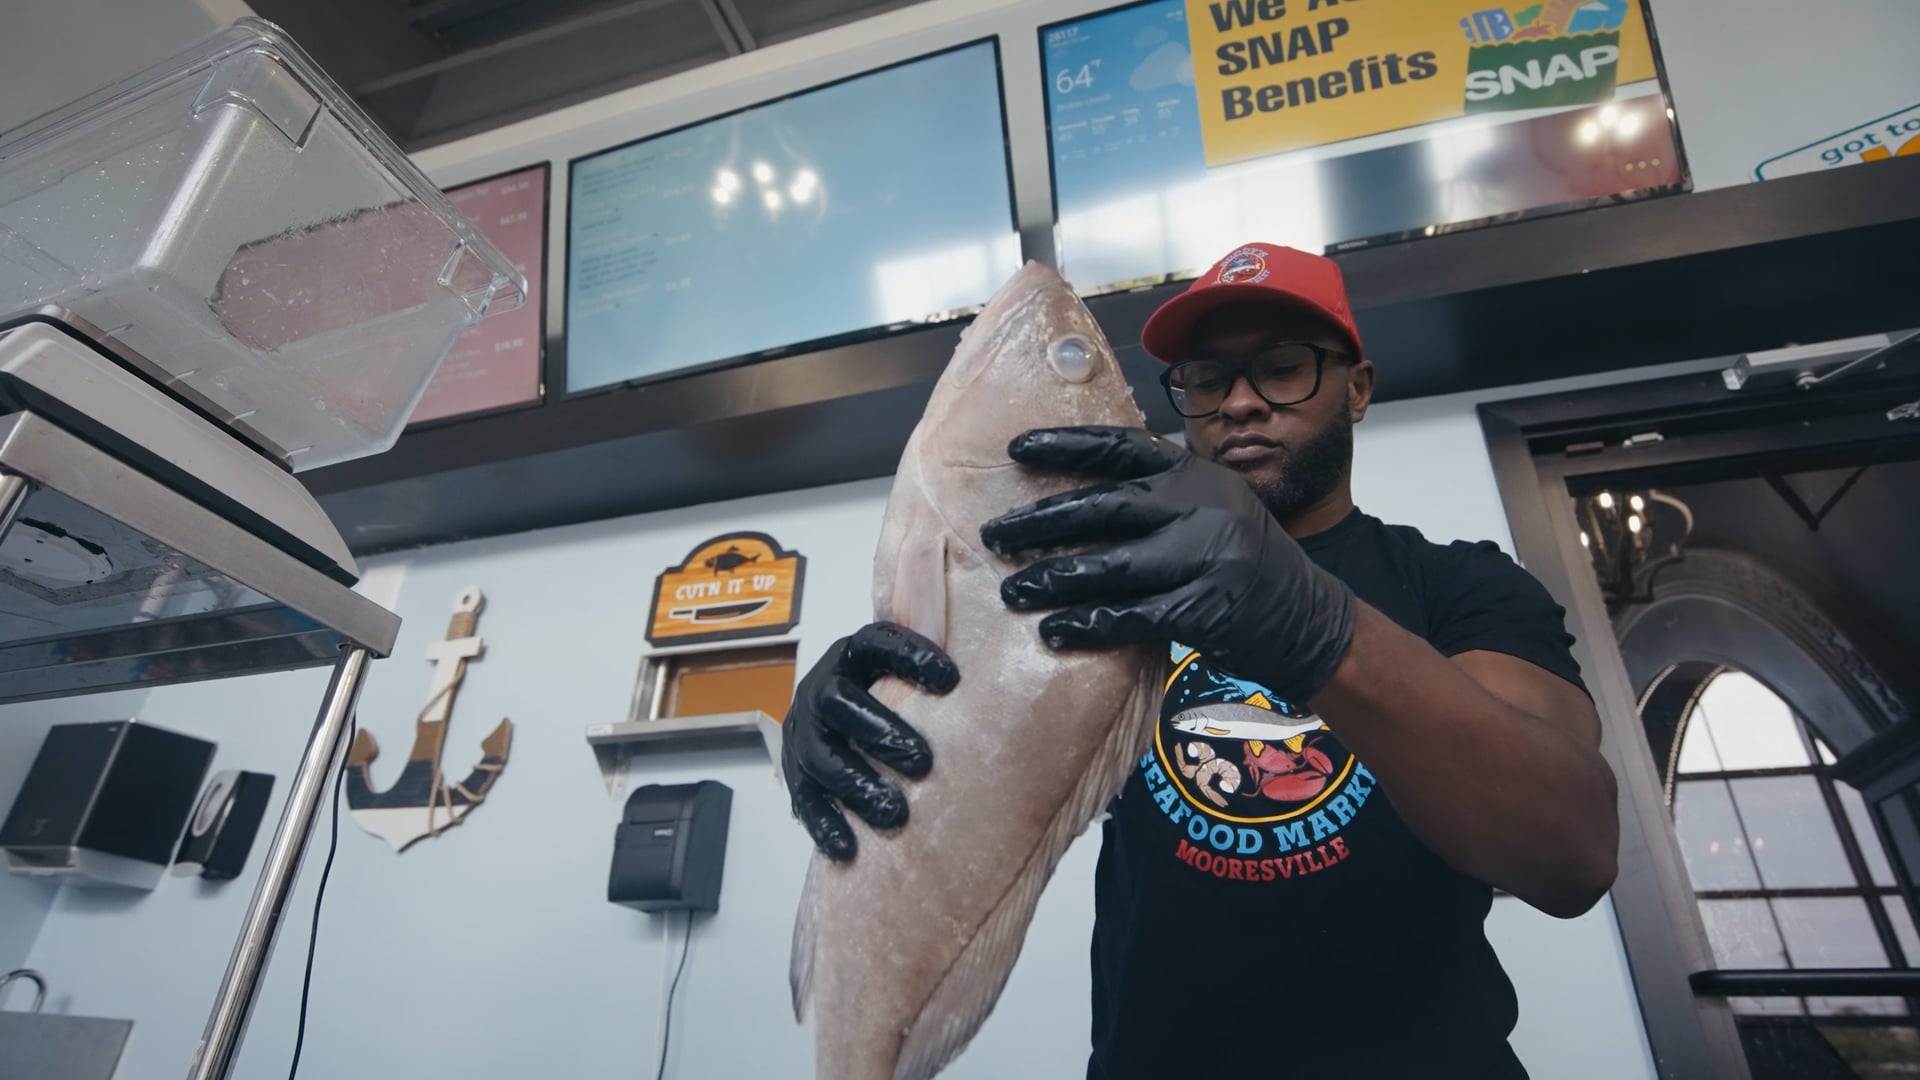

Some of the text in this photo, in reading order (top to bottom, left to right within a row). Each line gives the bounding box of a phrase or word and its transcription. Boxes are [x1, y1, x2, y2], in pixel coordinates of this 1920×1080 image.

[1209, 0, 1286, 33] We
[1216, 17, 1349, 76] SNAP
[1221, 51, 1438, 121] Benefits
[1465, 45, 1620, 101] SNAP
[1821, 132, 1881, 165] got
[727, 578, 744, 594] IT
[752, 575, 776, 591] UP
[1140, 747, 1263, 854] SEAFOOD
[1175, 836, 1350, 881] MOORESVILLE
